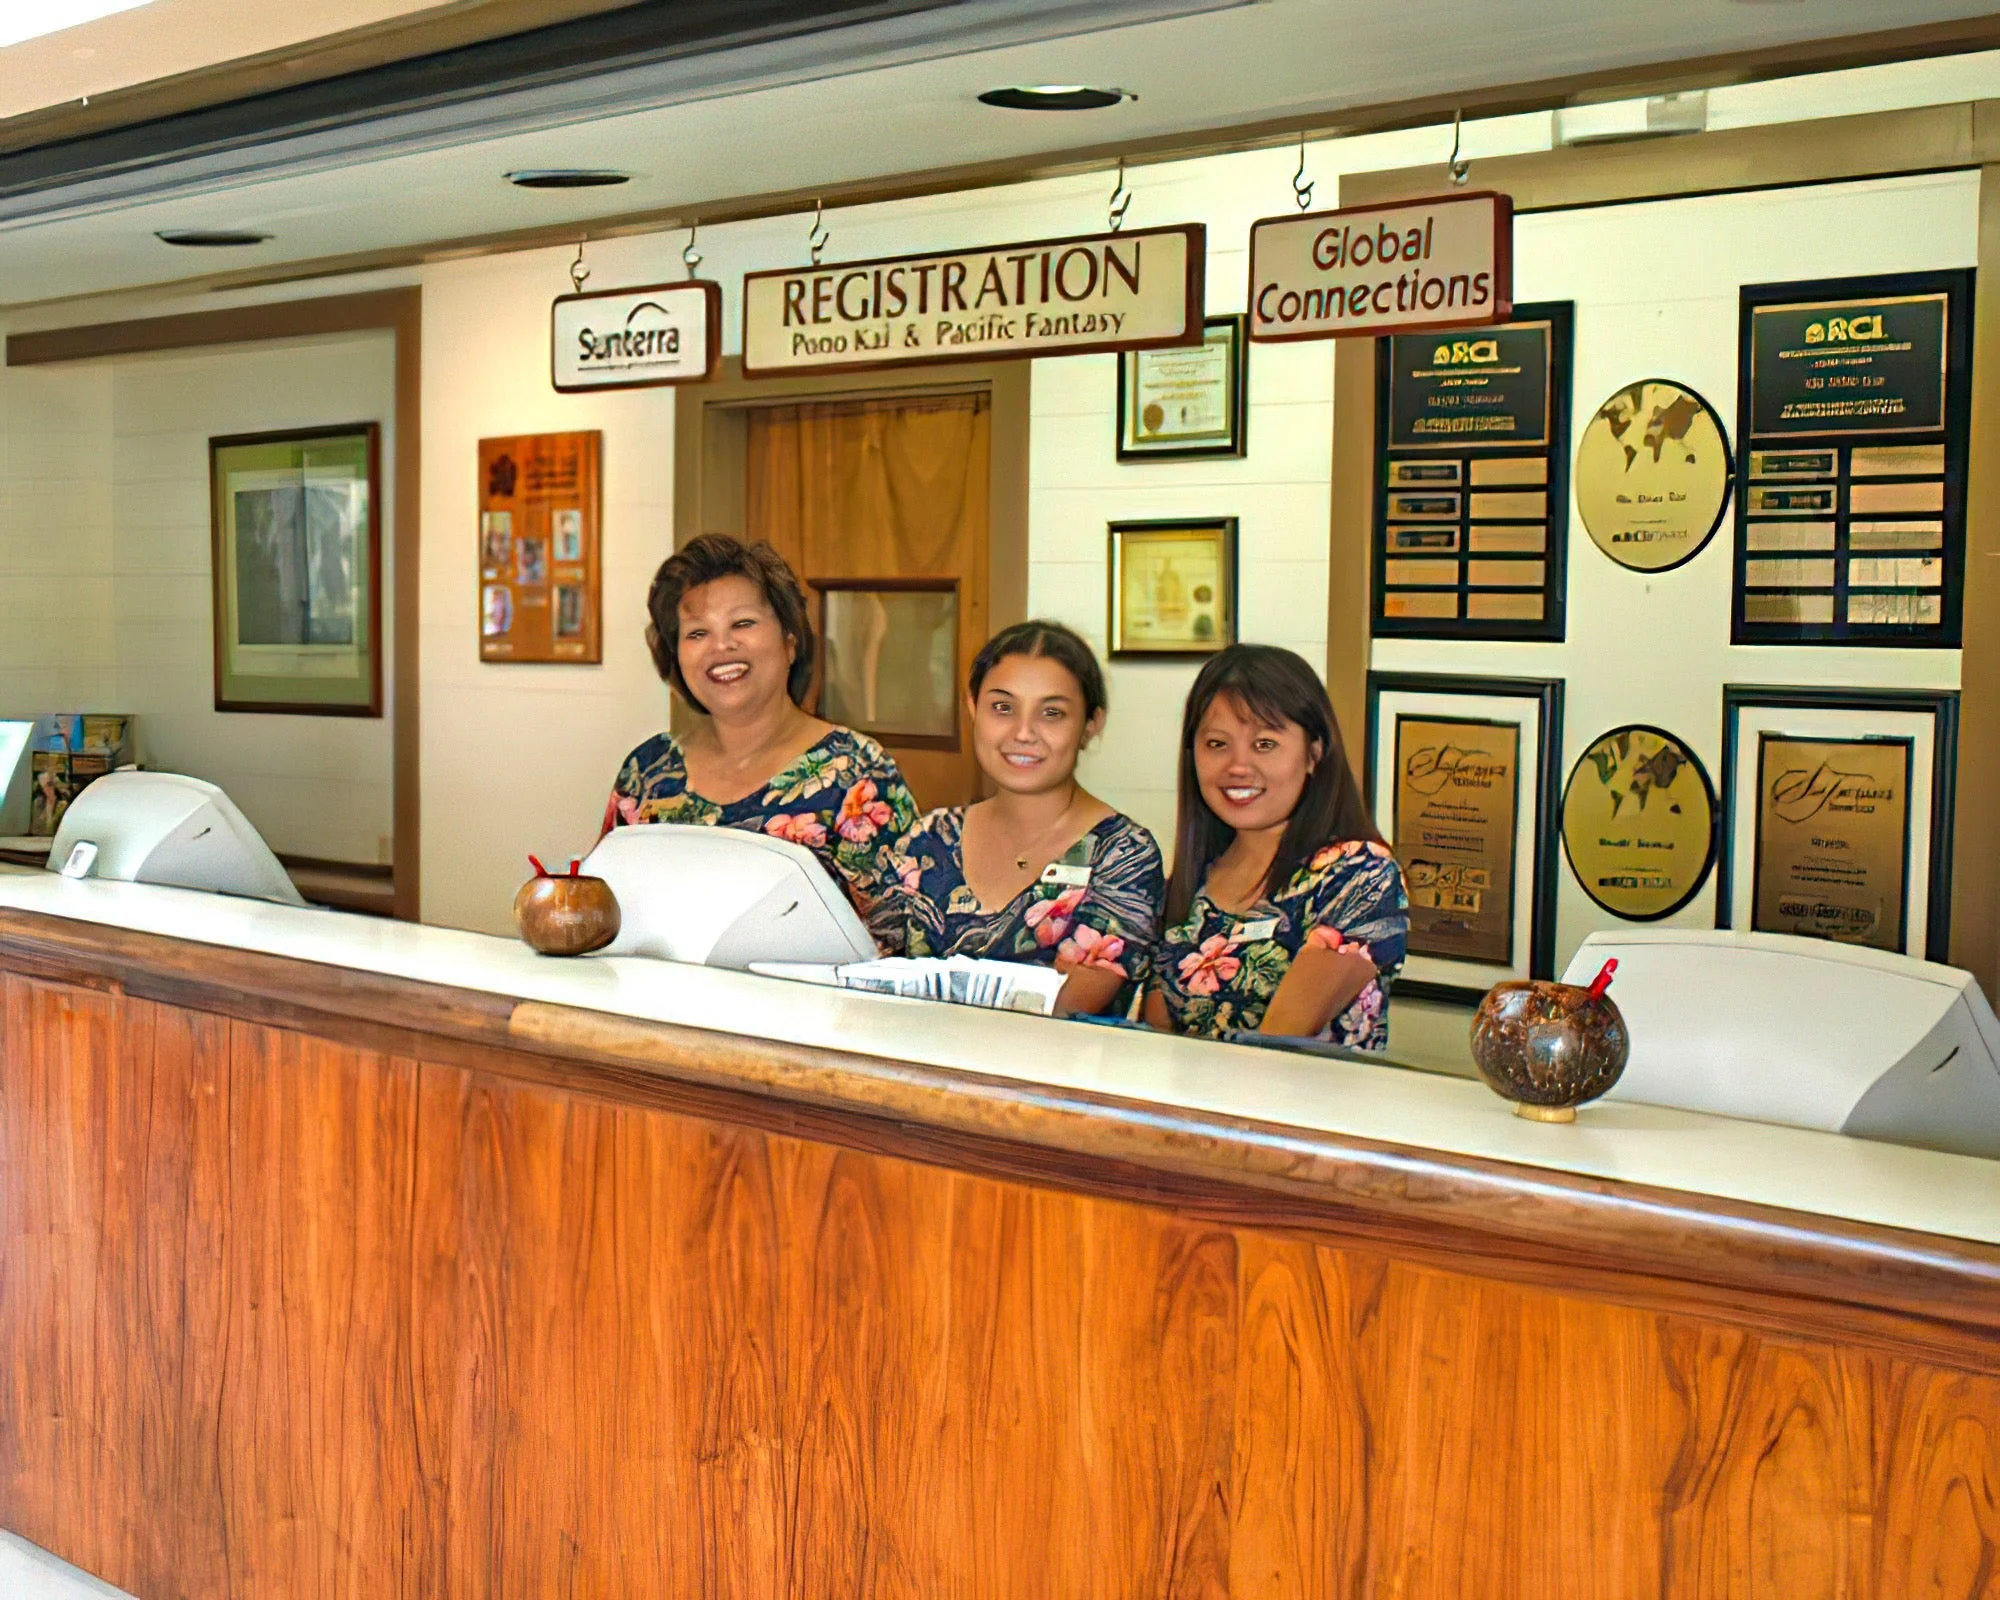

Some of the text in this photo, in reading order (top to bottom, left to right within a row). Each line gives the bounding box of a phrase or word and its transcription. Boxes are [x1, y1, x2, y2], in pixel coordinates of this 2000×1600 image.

[1312, 216, 1433, 270] Global
[783, 241, 1140, 327] REGISTRATION
[1256, 268, 1489, 324] Connections
[578, 327, 680, 361] Sunterra
[904, 323, 920, 348] &
[937, 312, 1016, 346] Pacific
[1025, 312, 1125, 338] Fantasy
